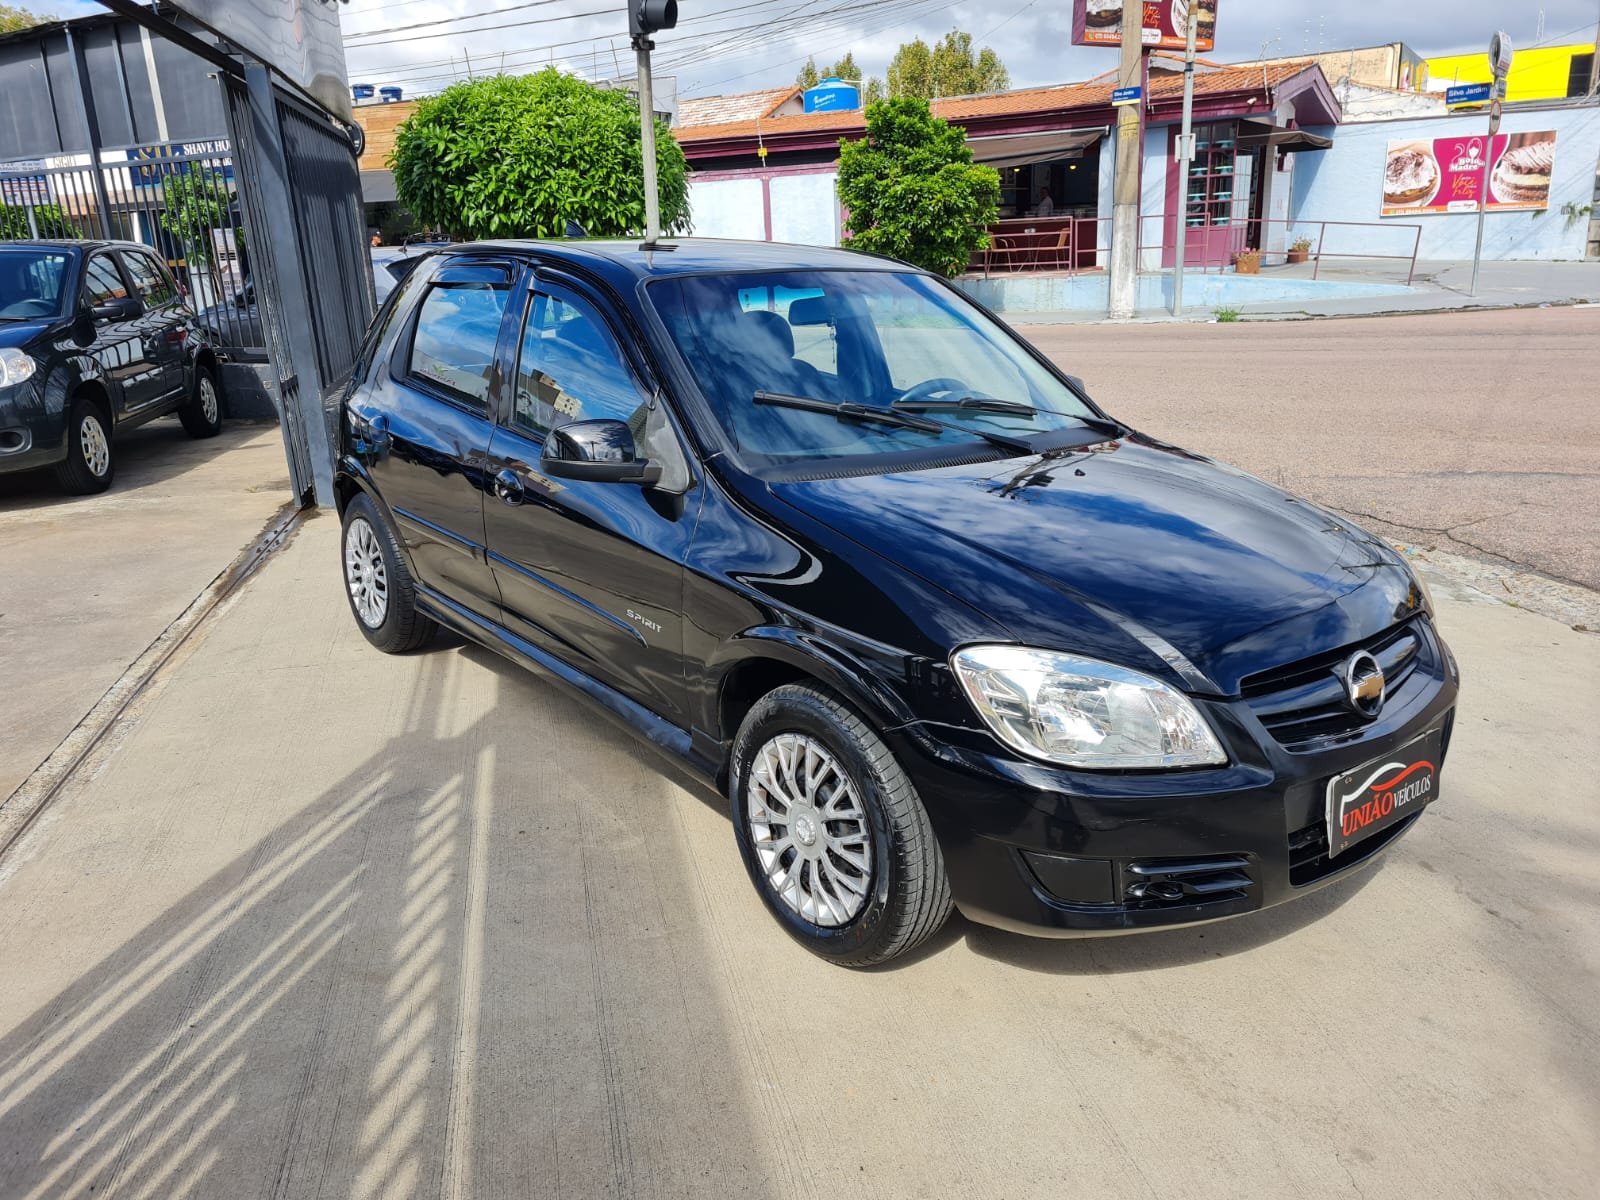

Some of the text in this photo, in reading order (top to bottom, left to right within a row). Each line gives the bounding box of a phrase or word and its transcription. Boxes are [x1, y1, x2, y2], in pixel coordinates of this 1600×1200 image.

[1465, 87, 1488, 95] Jardim
[183, 139, 232, 156] SHAVE HO
[626, 609, 662, 632] SPIRIT
[1342, 774, 1431, 837] UNIÃO VEÍCULOS
